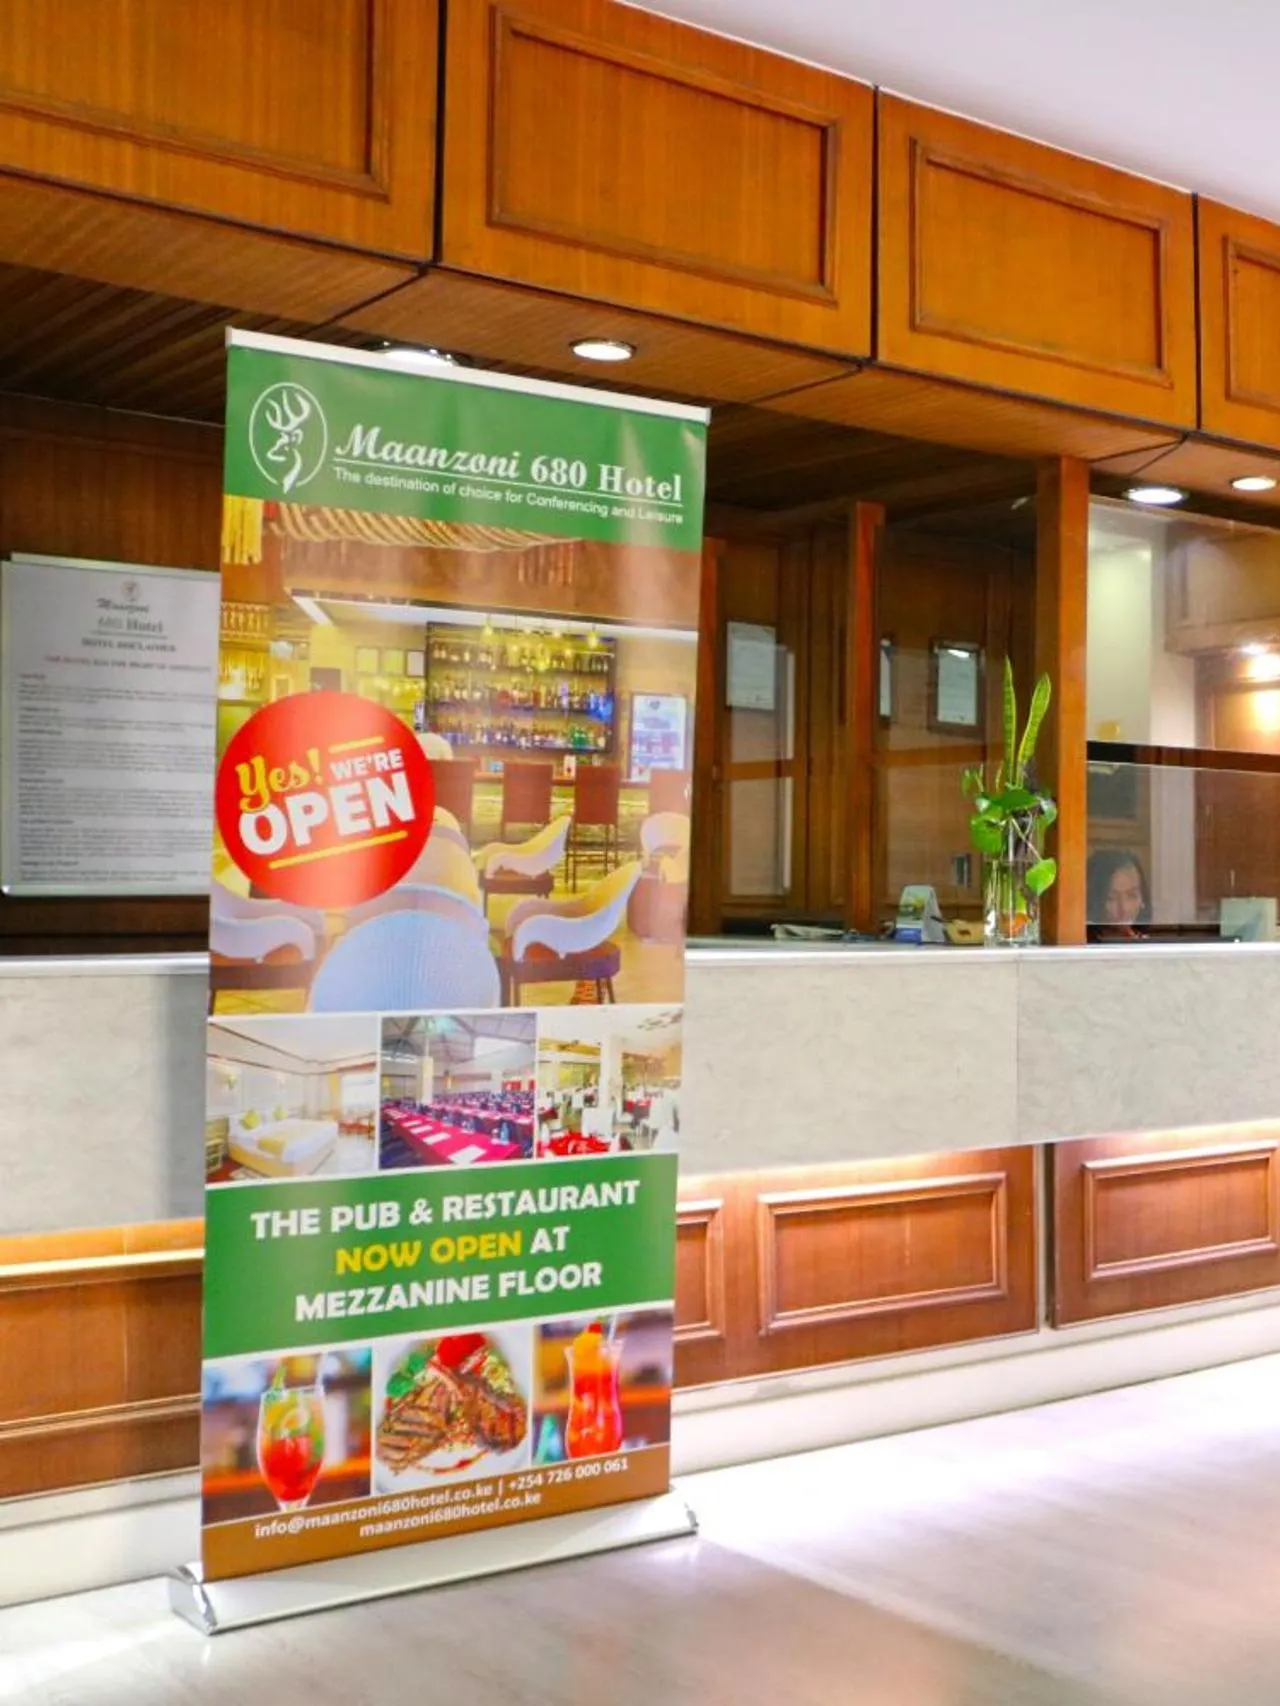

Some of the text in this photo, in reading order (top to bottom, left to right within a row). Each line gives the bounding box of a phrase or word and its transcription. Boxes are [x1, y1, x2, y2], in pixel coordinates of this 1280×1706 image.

[335, 423, 682, 501] Maanzoni 680 Hotel
[333, 466, 684, 524] The destination of choice for Conferencing and Leisure
[329, 748, 404, 781] WE'RE
[239, 771, 416, 856] OPEN
[250, 1180, 640, 1239] THE PUB & RESTAURANT
[335, 1226, 570, 1275] NOW OPEN AT
[294, 1261, 602, 1322] MEZZANINE FLOOR
[255, 1482, 493, 1538] info@maanzoni680hotel.co.ke
[508, 1474, 543, 1491] +254
[547, 1469, 572, 1484] 726
[575, 1463, 601, 1480] 000
[604, 1457, 628, 1473] 061
[360, 1490, 541, 1537] maanzoni680hotel.co.ke
